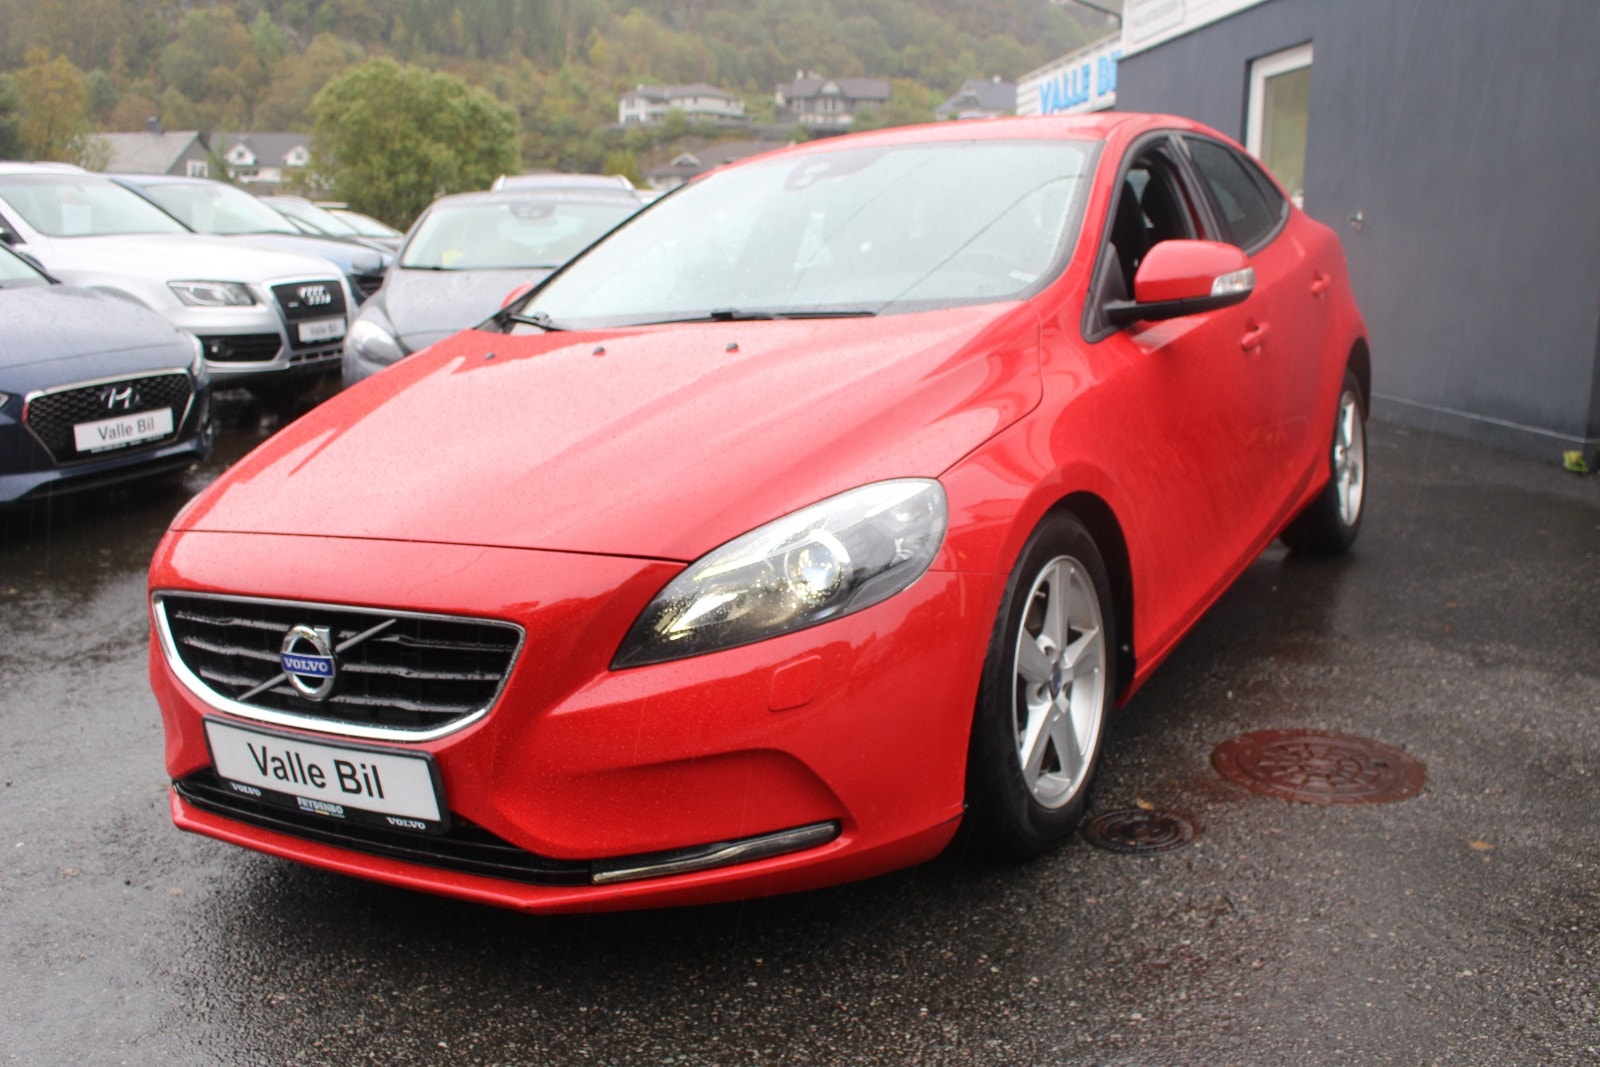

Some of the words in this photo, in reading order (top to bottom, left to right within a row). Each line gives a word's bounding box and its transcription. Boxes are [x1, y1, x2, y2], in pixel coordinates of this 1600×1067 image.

[1039, 64, 1090, 115] VALLE
[97, 422, 133, 441] Valle
[136, 417, 155, 433] Bil
[283, 656, 329, 673] VOLVO
[246, 742, 327, 789] Valle
[333, 759, 385, 799] Bil
[230, 782, 262, 797] VOLVO
[385, 816, 426, 830] VOLVO
